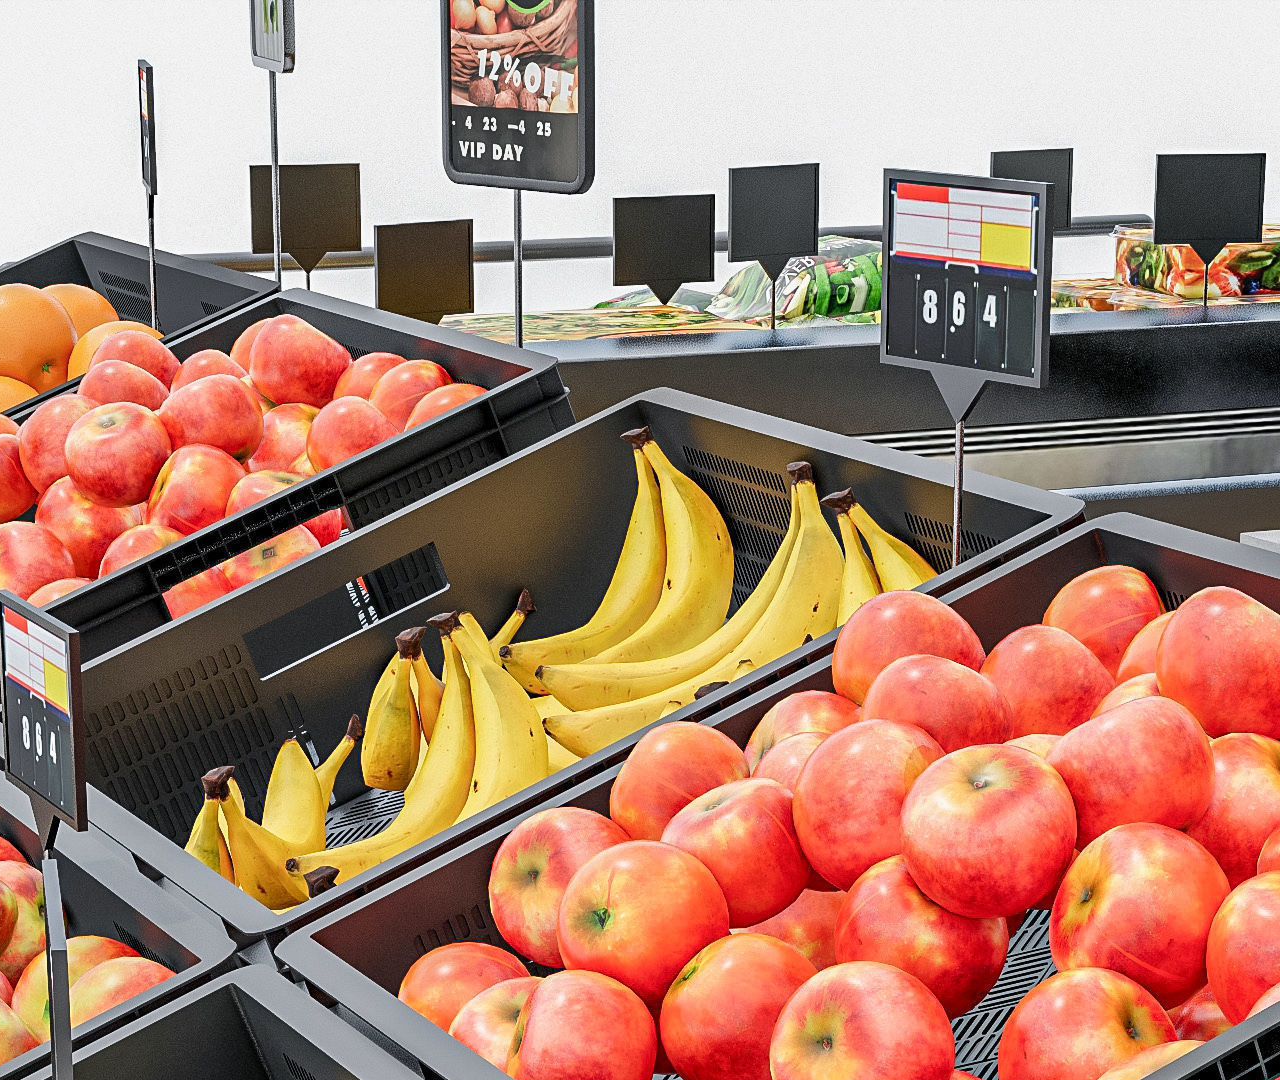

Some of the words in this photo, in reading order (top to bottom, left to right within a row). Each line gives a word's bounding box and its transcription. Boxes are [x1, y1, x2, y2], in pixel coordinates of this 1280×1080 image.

[477, 48, 575, 102] 12%OFF
[465, 115, 472, 129] 4
[482, 116, 497, 131] 23
[536, 120, 552, 136] 25
[458, 140, 486, 159] VIP
[492, 143, 524, 162] DAY
